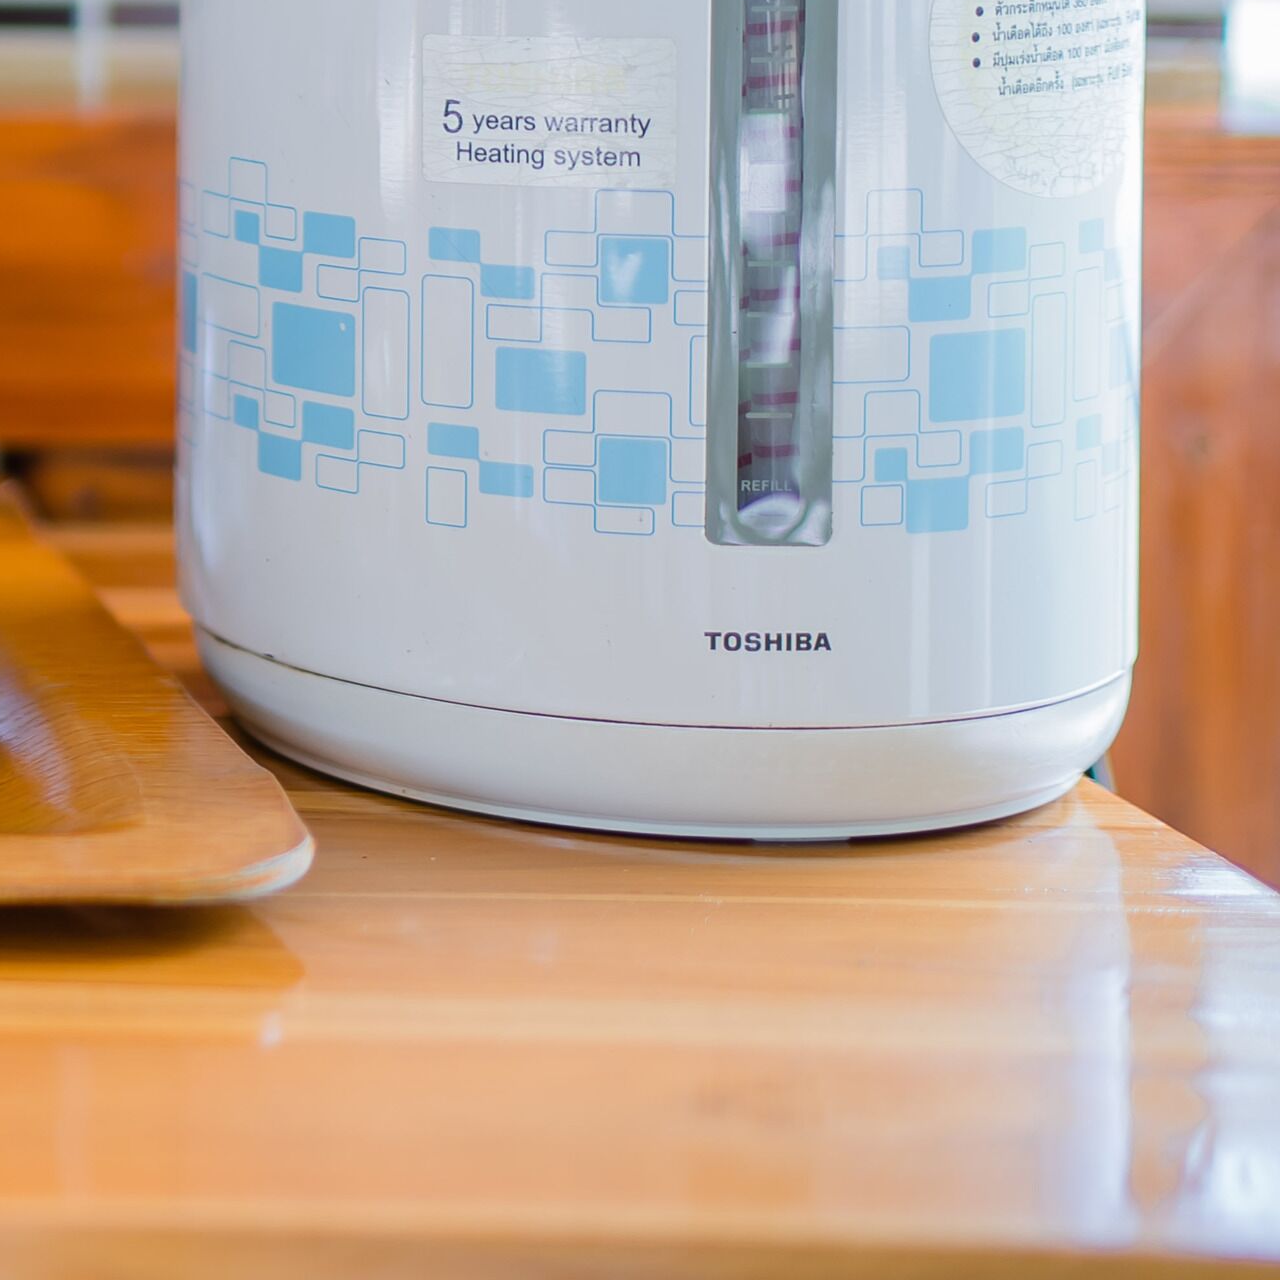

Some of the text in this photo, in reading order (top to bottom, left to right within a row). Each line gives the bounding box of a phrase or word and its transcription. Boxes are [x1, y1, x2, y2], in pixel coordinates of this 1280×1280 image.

[1056, 22, 1073, 36] 100
[442, 99, 652, 138] 5 years warranty
[456, 141, 642, 170] Heating system
[741, 479, 792, 493] REFILL
[704, 631, 832, 652] TOSHIBA
